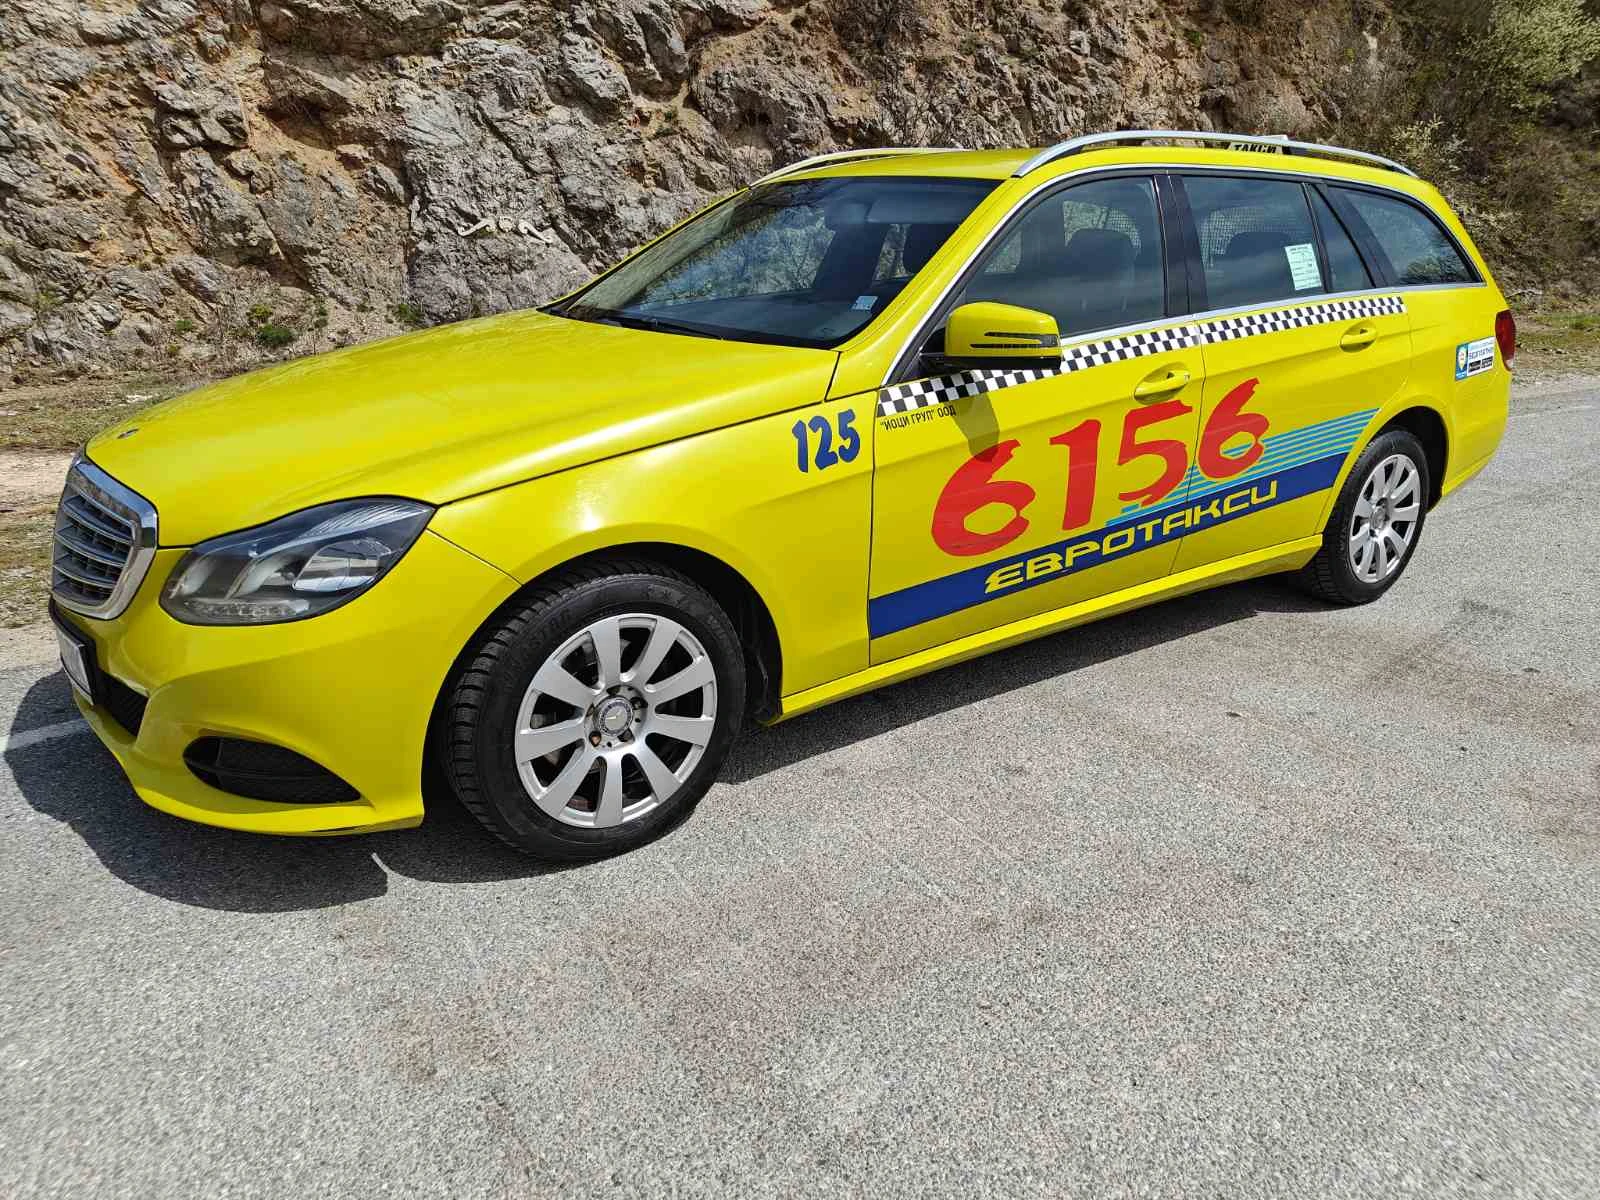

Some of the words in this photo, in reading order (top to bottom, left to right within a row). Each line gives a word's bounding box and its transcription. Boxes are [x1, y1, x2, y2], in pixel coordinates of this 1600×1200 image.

[792, 409, 860, 473] 125
[937, 404, 957, 418] ООД
[931, 378, 1269, 556] 6156
[984, 479, 1278, 594] ЕВРОТАКСИ
